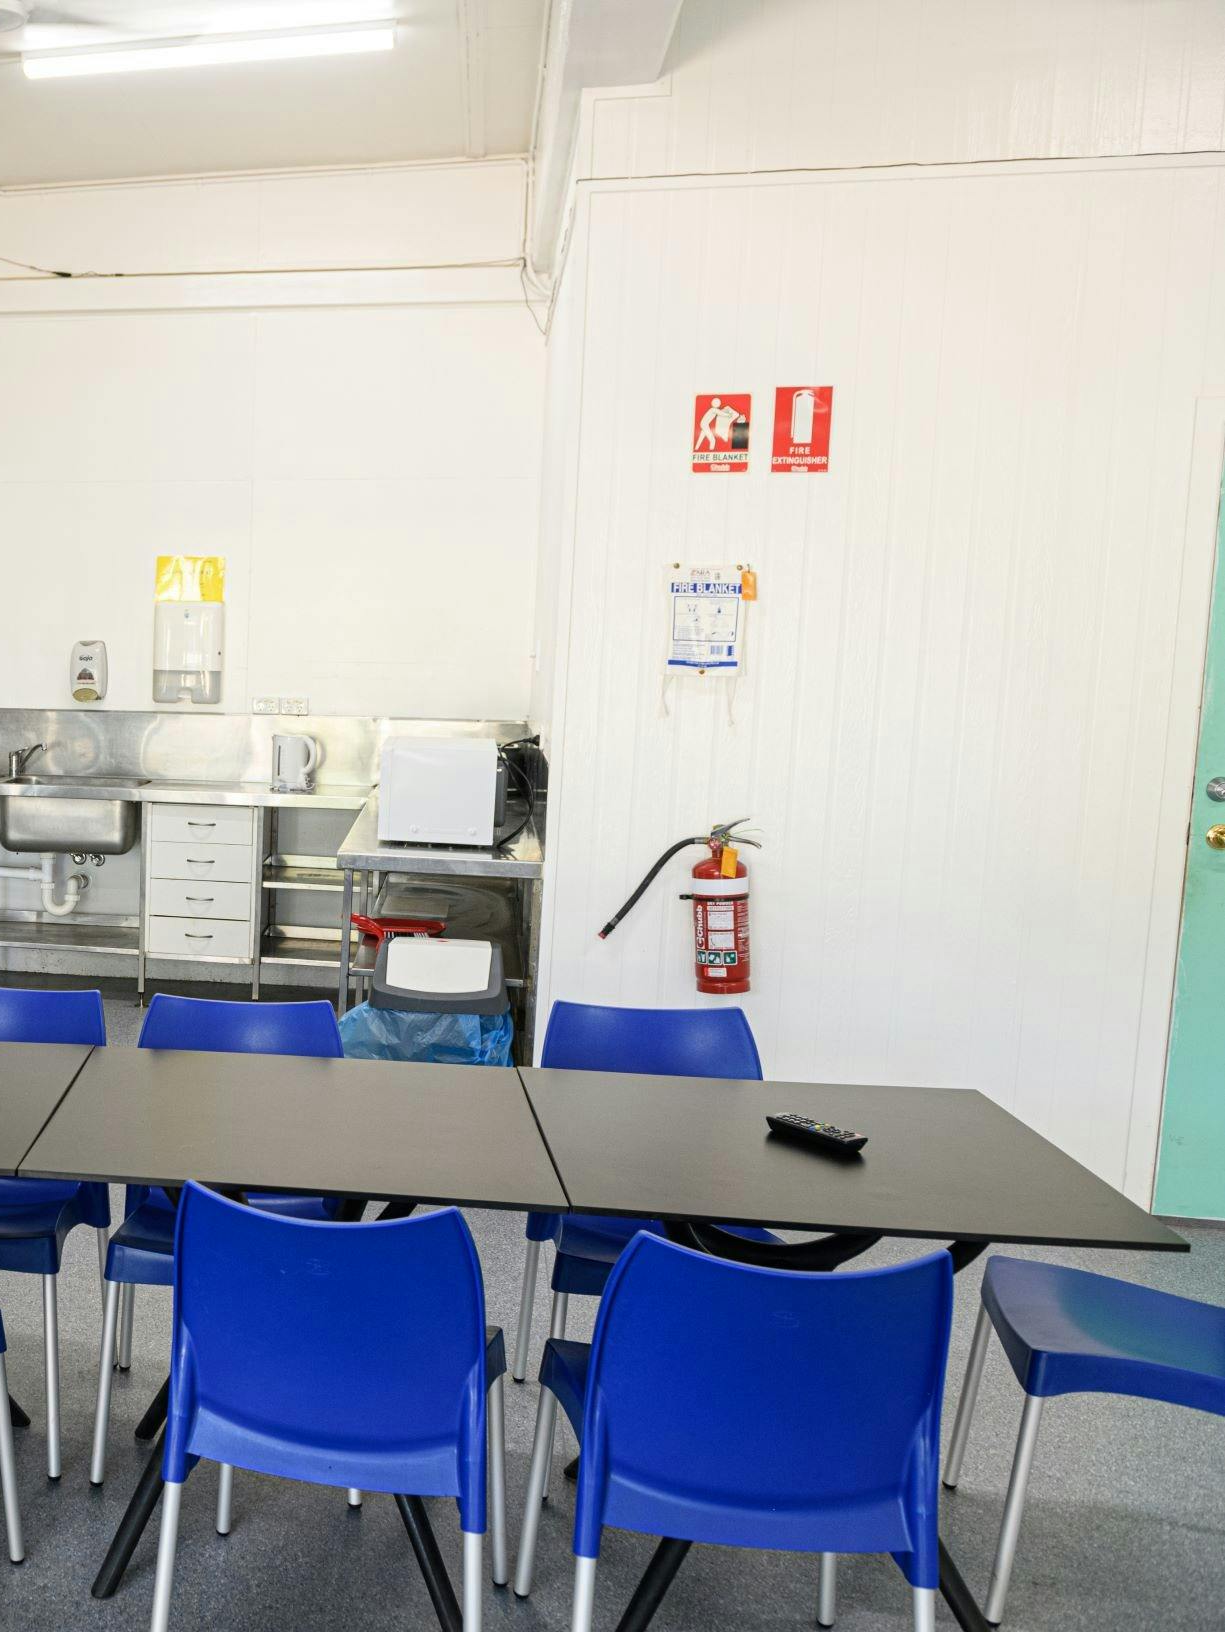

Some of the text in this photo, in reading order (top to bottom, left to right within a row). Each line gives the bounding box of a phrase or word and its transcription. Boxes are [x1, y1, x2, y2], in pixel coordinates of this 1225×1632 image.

[789, 446, 811, 455] FIRE
[692, 453, 748, 462] FIRE BLANKET
[772, 456, 828, 465] EXTINGUISHER
[673, 583, 741, 595] FIRE BLANKET
